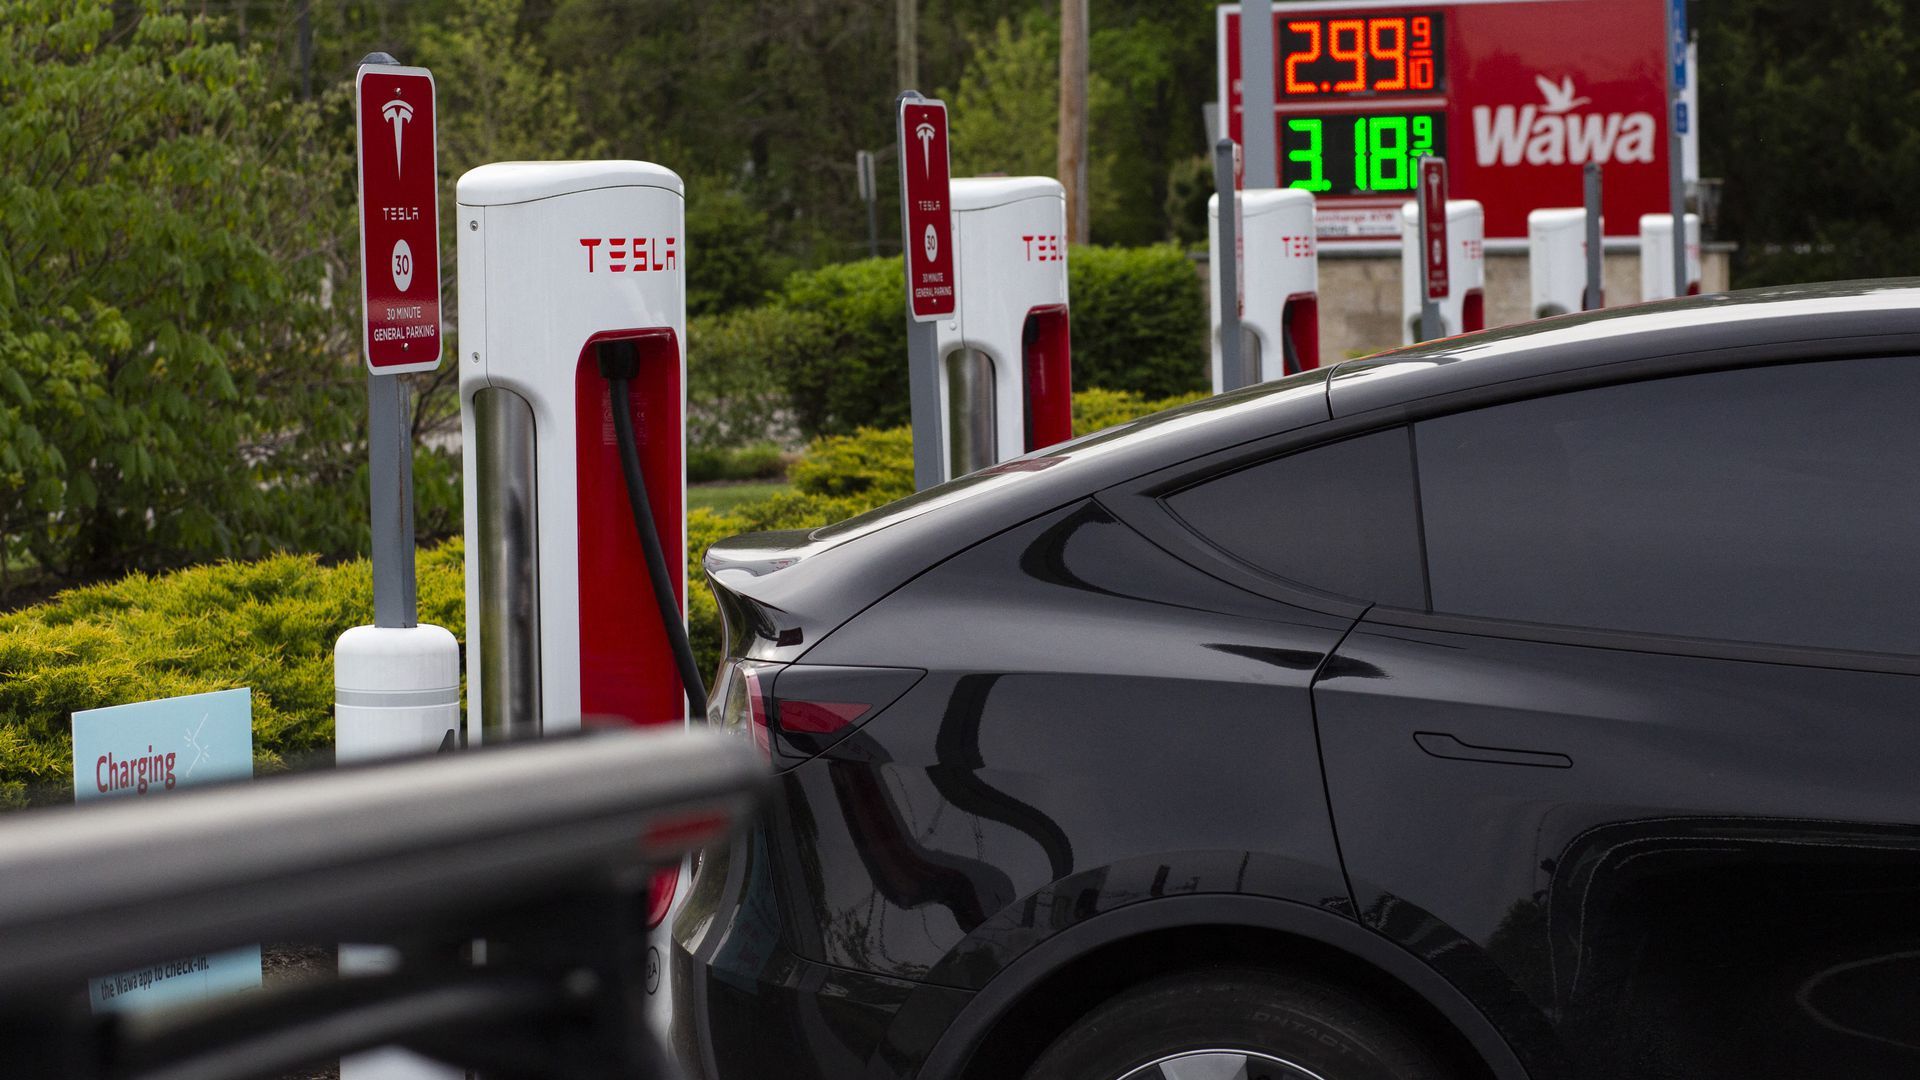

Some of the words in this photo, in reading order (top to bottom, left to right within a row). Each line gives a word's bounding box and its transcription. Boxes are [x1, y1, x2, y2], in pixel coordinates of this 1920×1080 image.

[1285, 18, 1407, 95] 2.99
[1472, 103, 1656, 167] Wawa
[1288, 116, 1408, 191] 3.18
[383, 207, 419, 220] TESLA
[918, 200, 940, 211] TESLA
[926, 235, 936, 251] 30
[579, 237, 676, 273] TESLA
[395, 254, 410, 276] 30
[929, 272, 944, 282] MINUTE
[915, 287, 935, 298] GENERAL
[934, 286, 952, 297] PARKING
[386, 308, 396, 321] 30
[396, 306, 422, 319] MINUTE
[373, 327, 406, 341] GENERAL
[406, 325, 435, 339] PARKING
[95, 744, 177, 795] Charging
[101, 979, 114, 1000] the
[115, 975, 138, 995] Wawa
[139, 968, 153, 991] app
[154, 966, 163, 981] to
